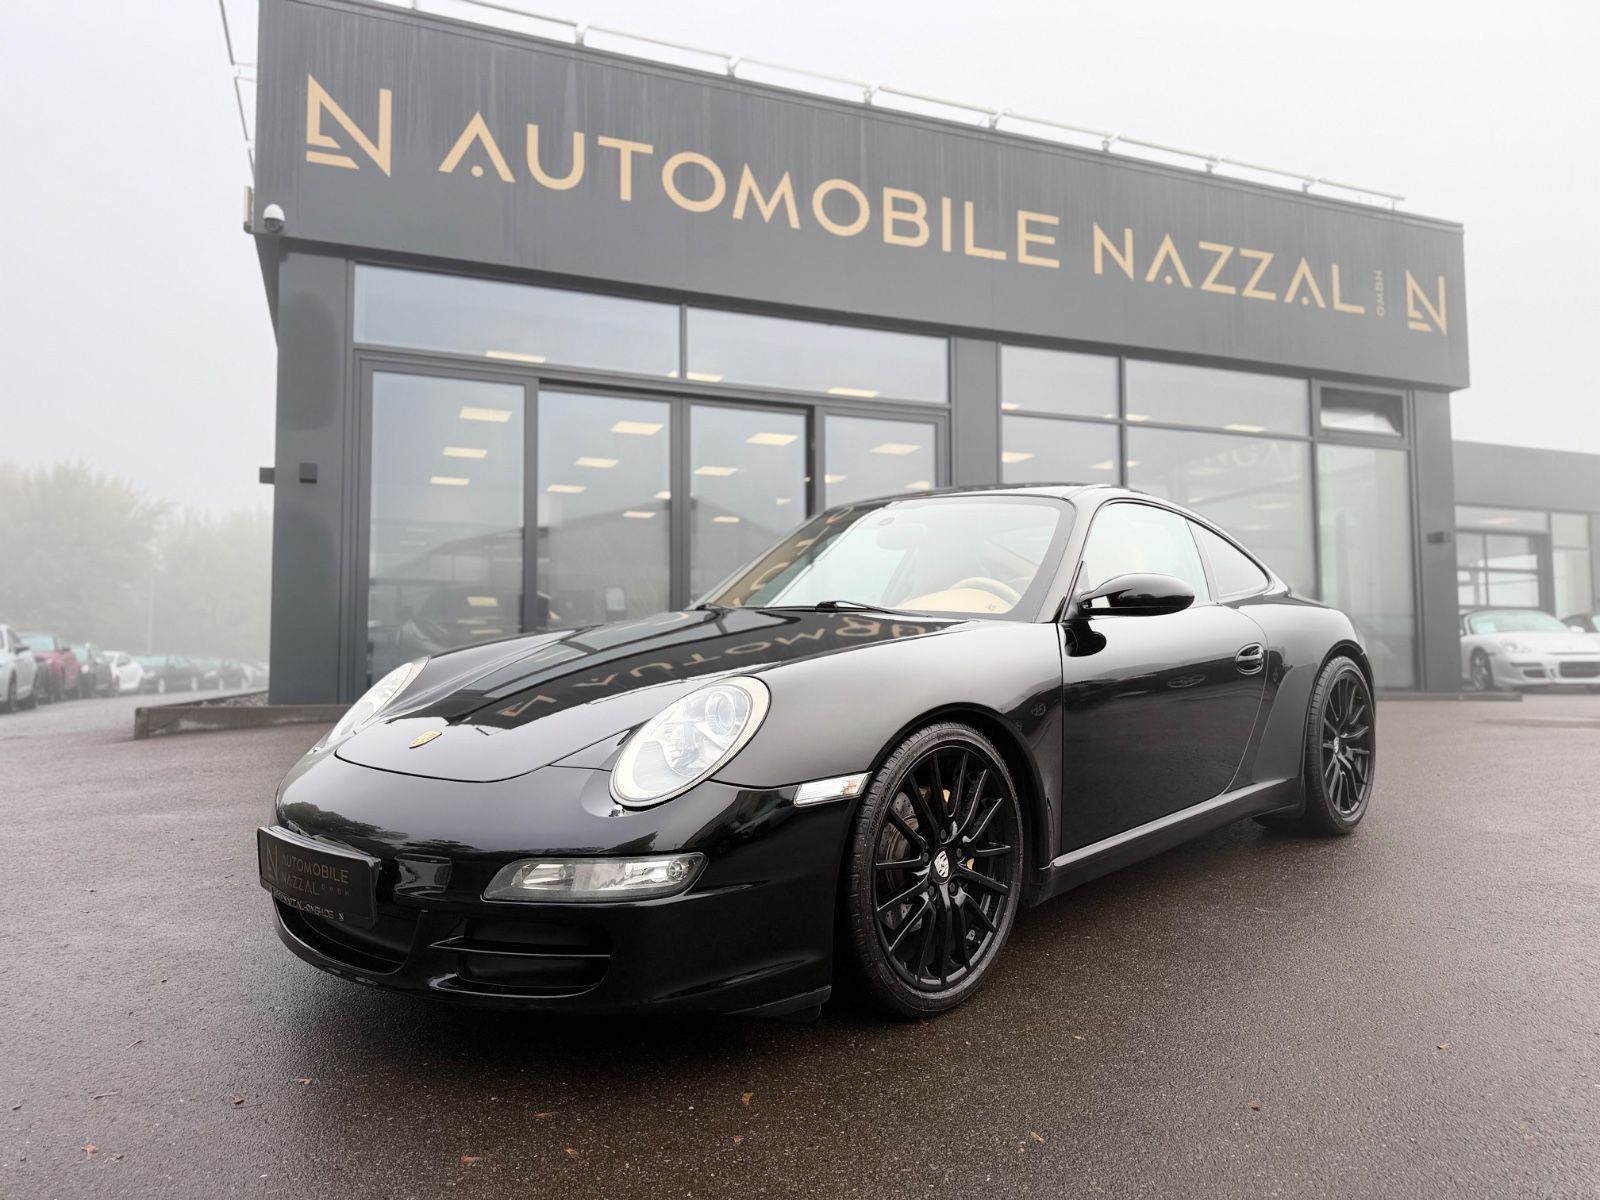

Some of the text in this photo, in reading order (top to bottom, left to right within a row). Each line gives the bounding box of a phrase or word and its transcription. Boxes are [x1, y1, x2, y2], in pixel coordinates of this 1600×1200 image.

[438, 111, 1366, 315] AUTOMOBILE NAZZAL
[281, 871, 320, 897] NAZZAL
[282, 853, 349, 885] AUTOMOBILE
